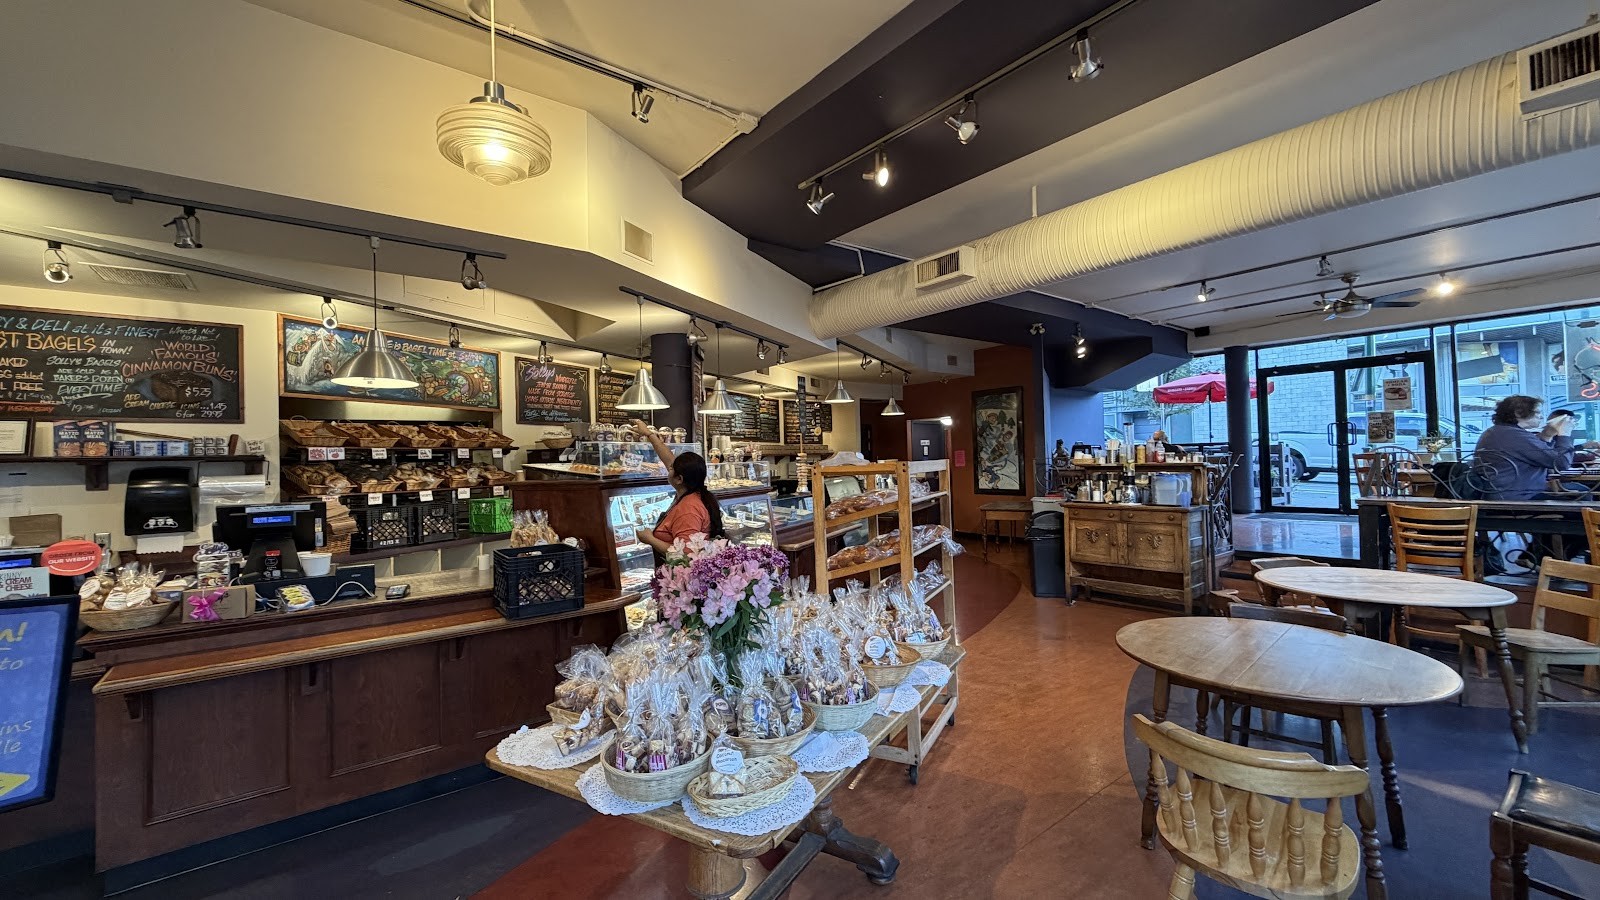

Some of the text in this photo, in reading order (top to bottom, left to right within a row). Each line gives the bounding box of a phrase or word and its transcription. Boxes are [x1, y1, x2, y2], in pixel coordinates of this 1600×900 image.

[15, 317, 28, 329] &
[31, 318, 71, 331] DELI
[72, 323, 88, 334] at
[114, 325, 164, 338] FINEST
[102, 339, 116, 347] IN
[100, 345, 133, 355] TOWN!
[402, 342, 427, 353] BAGEL
[428, 346, 447, 357] TIME
[121, 361, 192, 378] CINNAMON
[15, 371, 44, 381] added
[91, 375, 123, 384] DOZEN
[124, 400, 150, 409] CREAM
[150, 402, 177, 411] CHEESE
[65, 556, 96, 564] WEBSITE
[5, 576, 32, 585] CREAM
[5, 583, 33, 592] CHEESE
